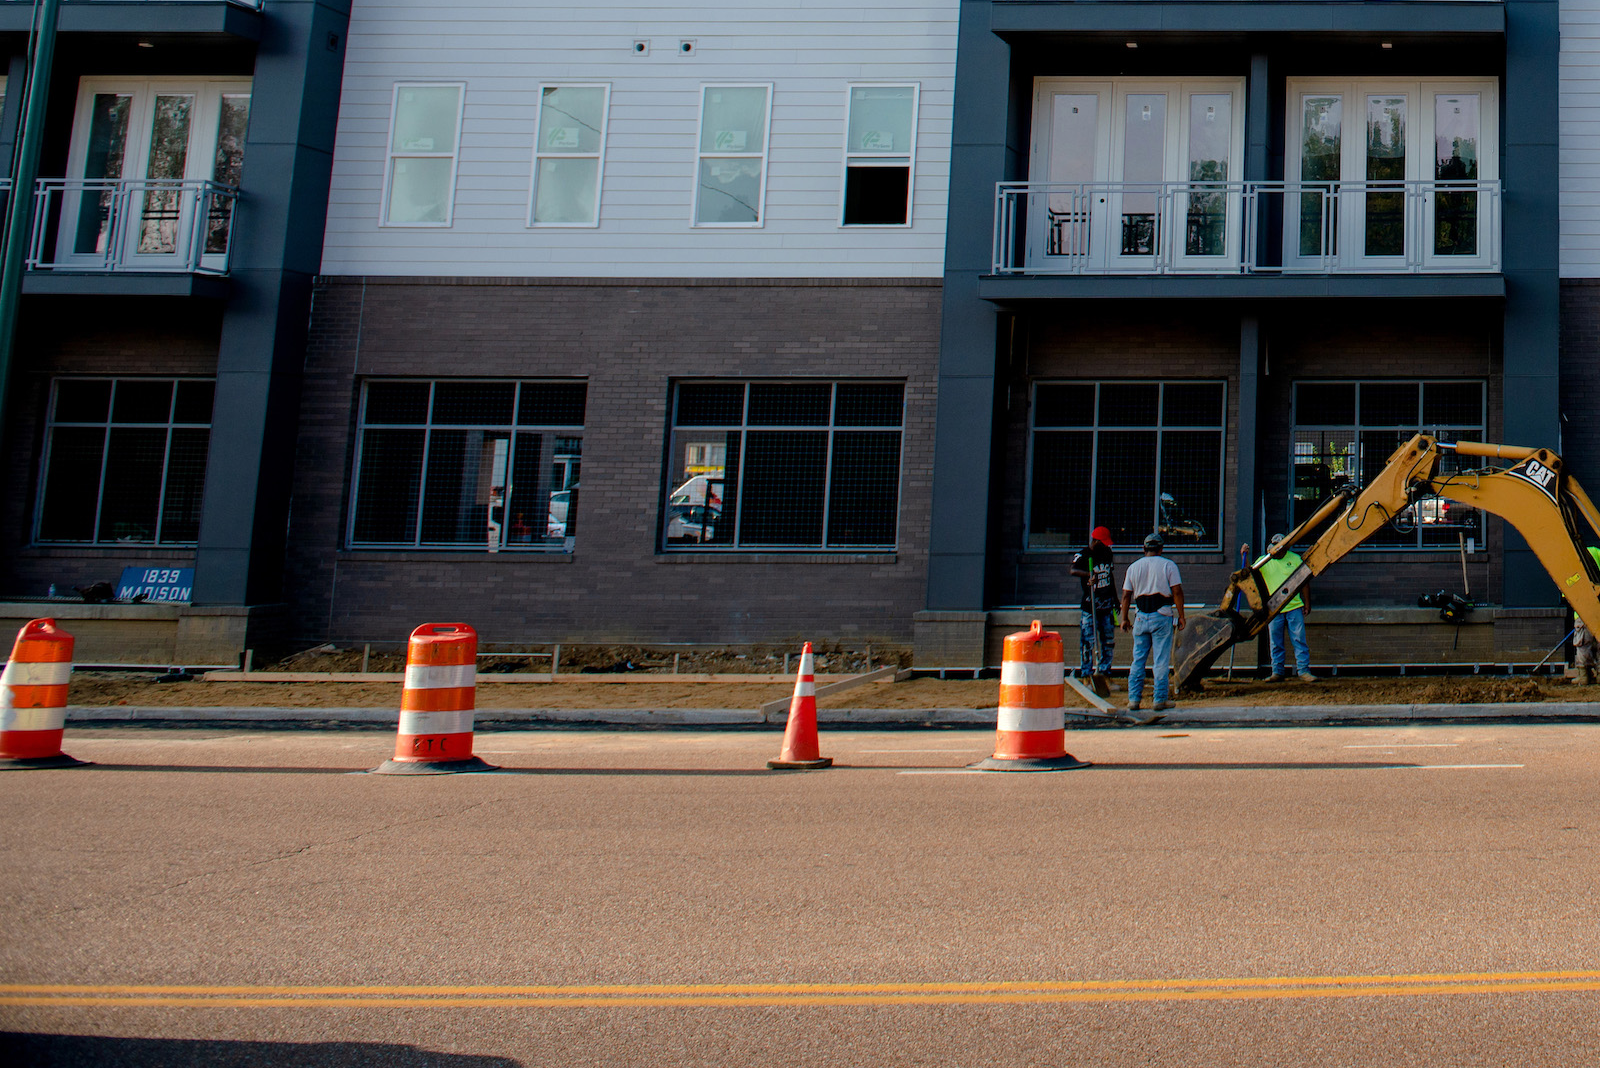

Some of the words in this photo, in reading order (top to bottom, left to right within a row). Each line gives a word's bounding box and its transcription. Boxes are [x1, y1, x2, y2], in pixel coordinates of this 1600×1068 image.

[1525, 460, 1556, 487] CAT
[141, 569, 181, 583] 1839
[119, 585, 192, 600] MADISON
